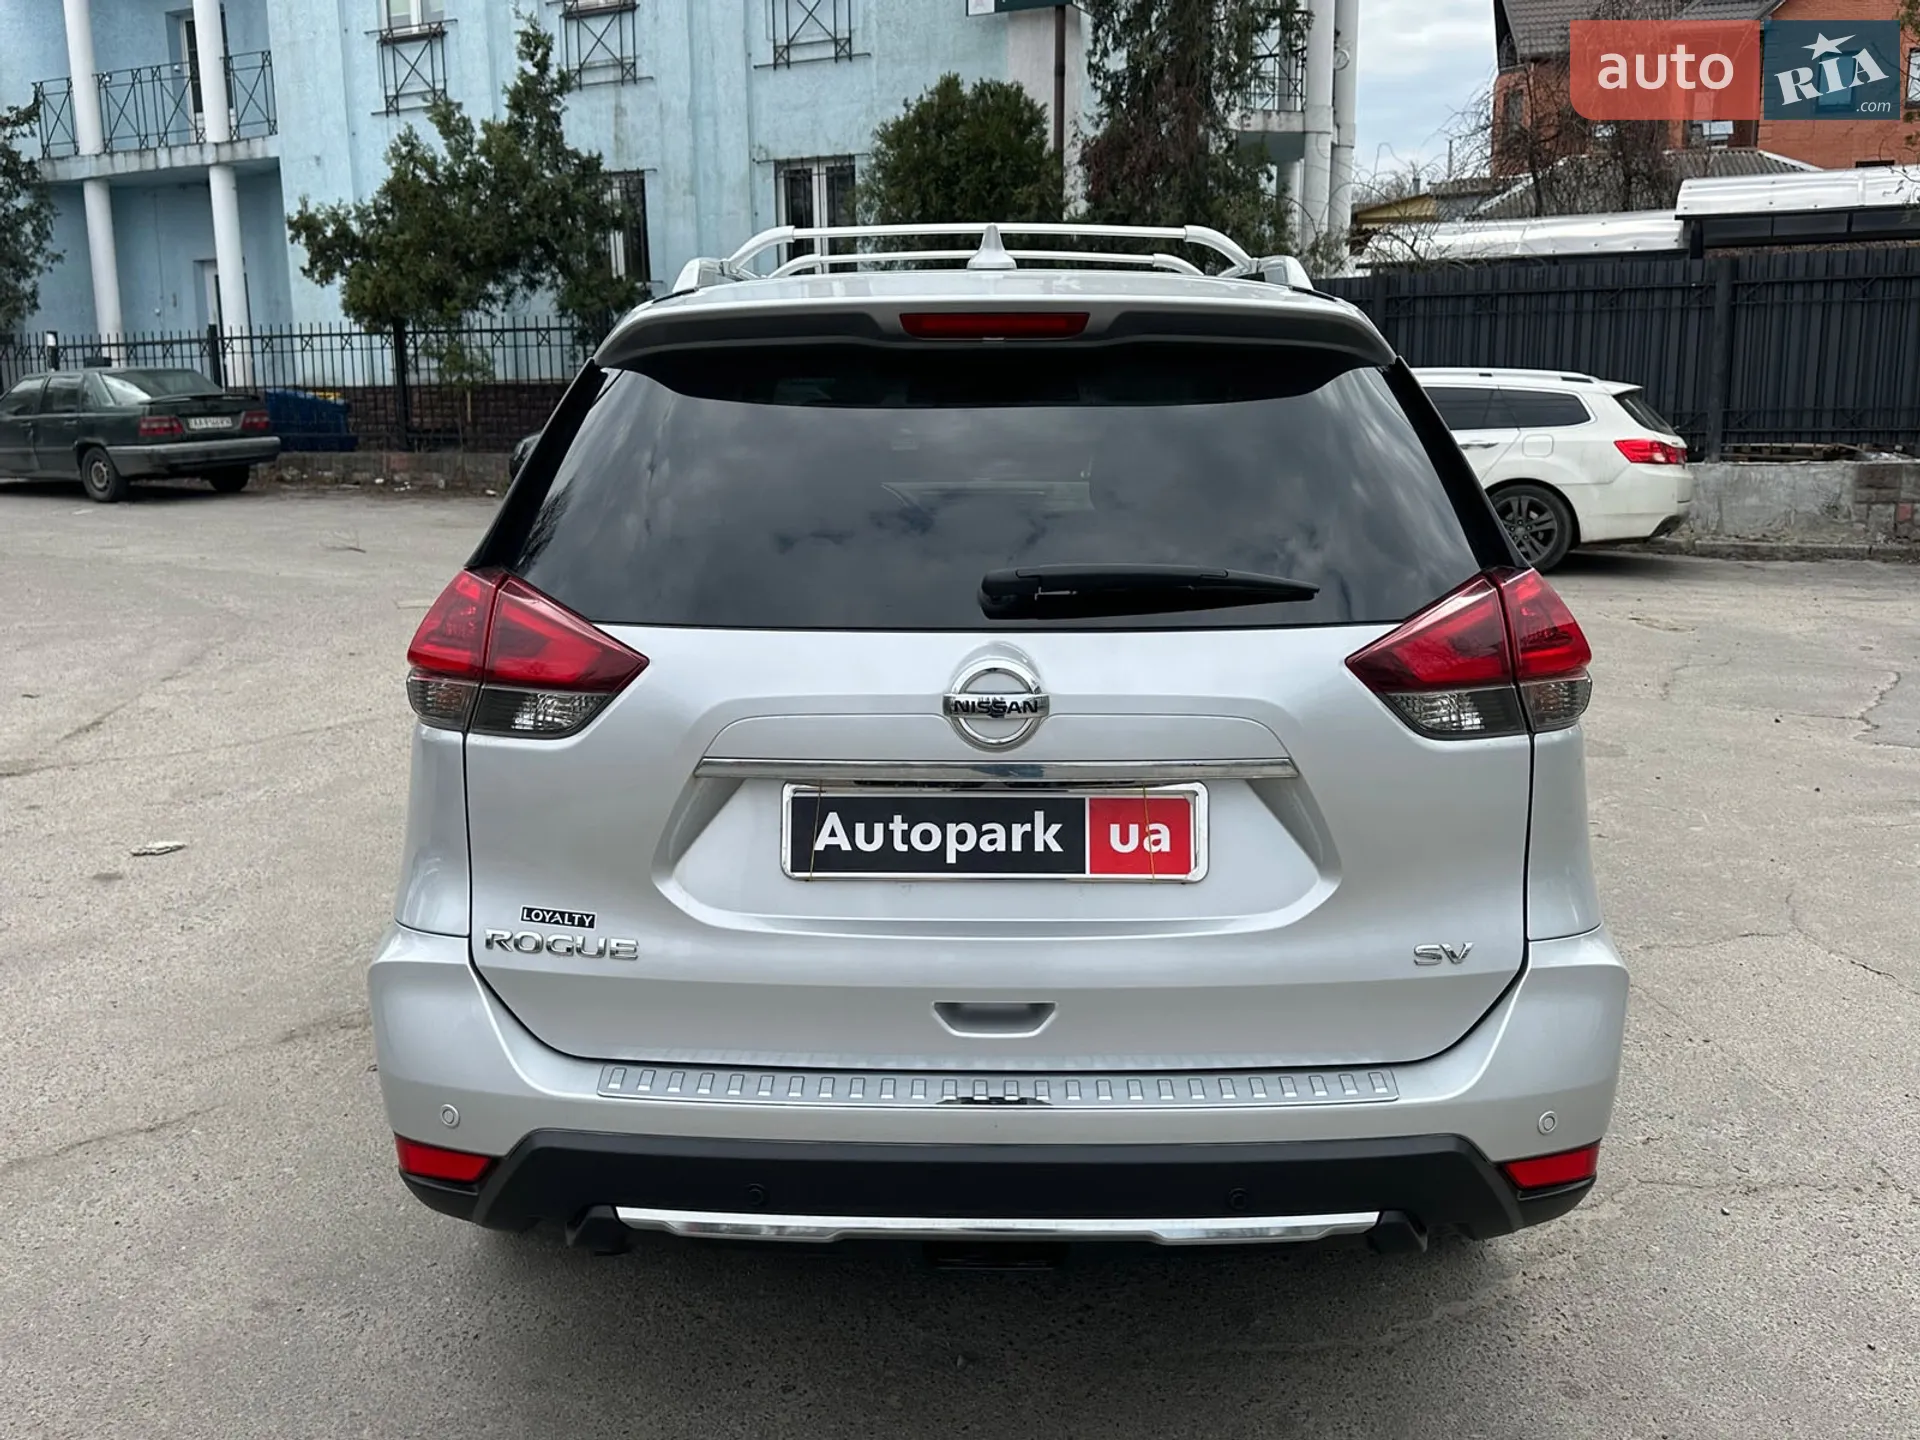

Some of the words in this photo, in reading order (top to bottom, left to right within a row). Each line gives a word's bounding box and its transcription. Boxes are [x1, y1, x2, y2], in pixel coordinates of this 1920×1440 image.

[953, 699, 1038, 714] NISSAN
[814, 810, 1063, 863] Autopark
[1109, 822, 1171, 853] ua
[523, 909, 593, 926] LOYALTY
[484, 928, 639, 960] ROGUE
[1413, 942, 1474, 966] SV
